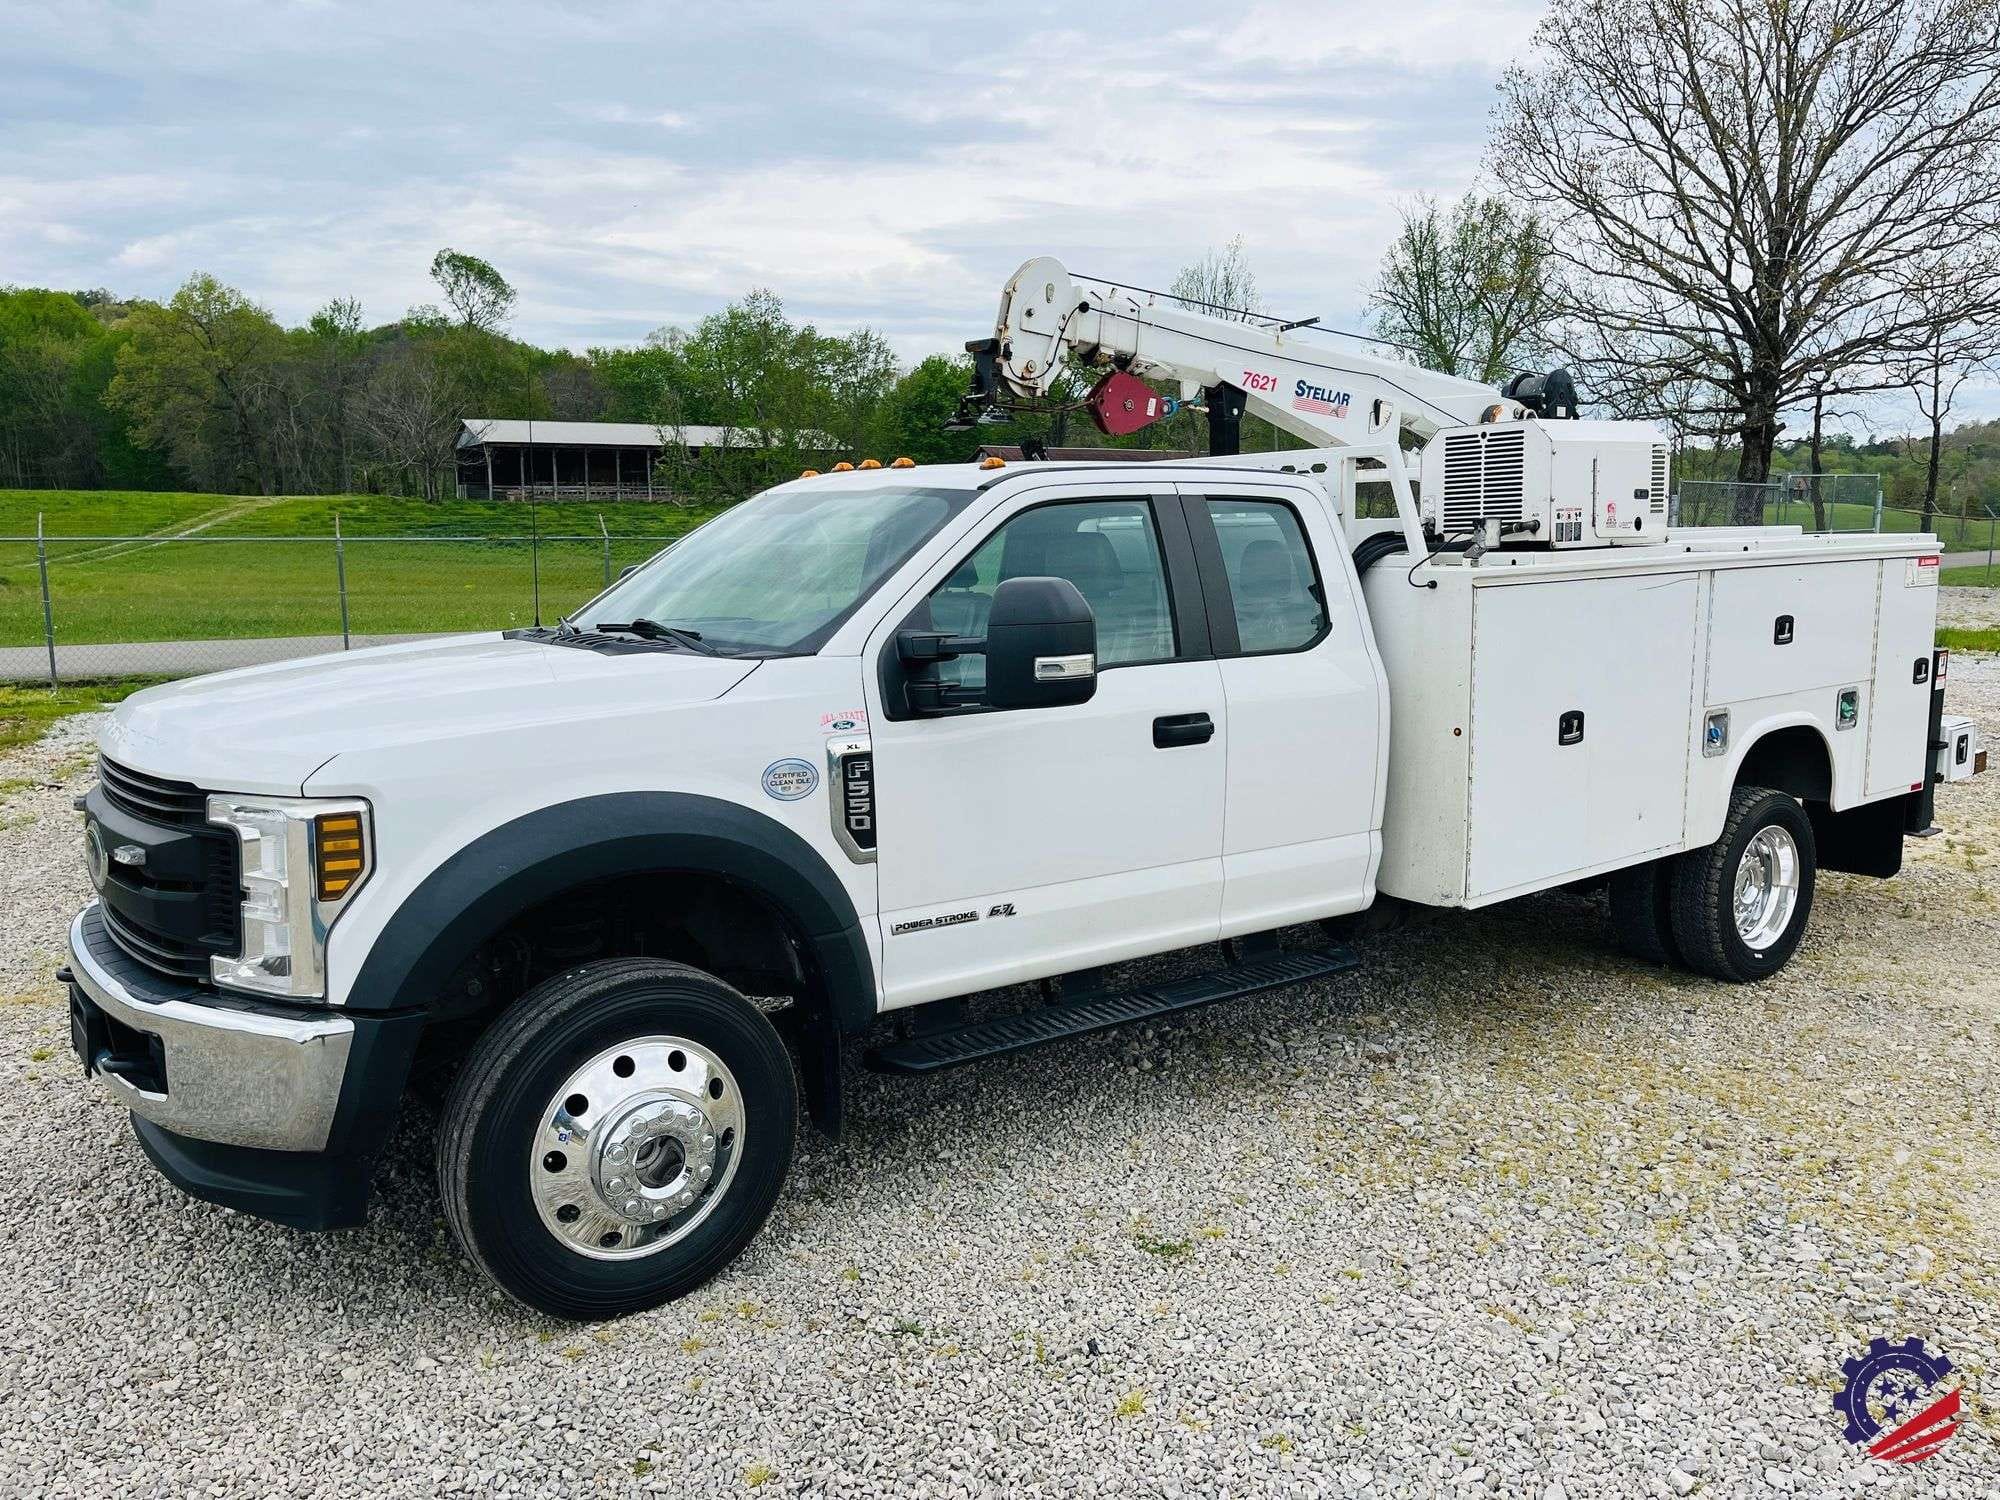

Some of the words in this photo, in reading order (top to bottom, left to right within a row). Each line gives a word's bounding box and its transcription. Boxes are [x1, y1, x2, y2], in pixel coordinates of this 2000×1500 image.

[1242, 371, 1278, 392] 7621
[1295, 379, 1351, 406] STELLAR
[847, 743, 861, 751] XL
[770, 779, 793, 787] CLEAN
[796, 777, 811, 785] IDLE
[773, 771, 808, 779] CERTIFIED
[848, 760, 871, 830] F550
[987, 903, 1018, 918] 6.7L
[895, 918, 933, 932] POWER
[935, 910, 978, 925] STROKE
